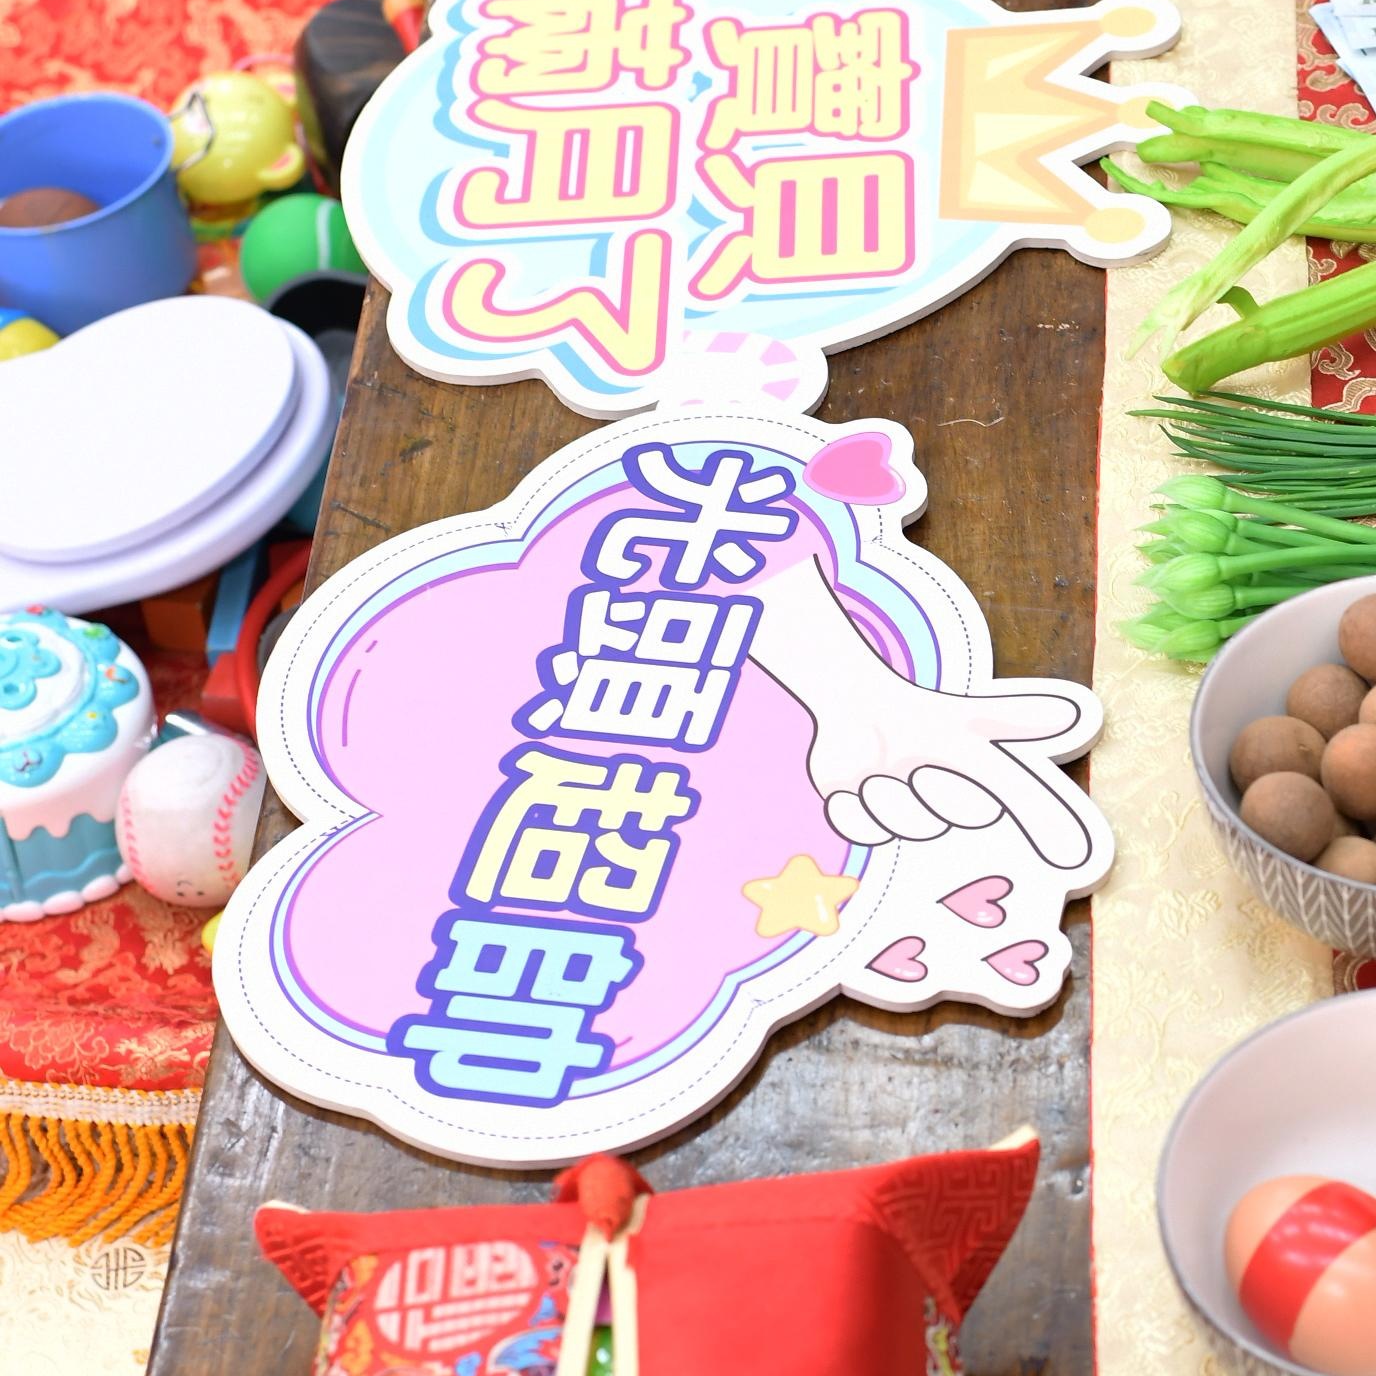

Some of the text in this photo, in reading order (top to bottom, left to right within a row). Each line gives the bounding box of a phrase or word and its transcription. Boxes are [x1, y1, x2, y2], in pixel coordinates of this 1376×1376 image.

[688, 7, 921, 301] 寶貝
[385, 442, 802, 1109] 光頭超帥
